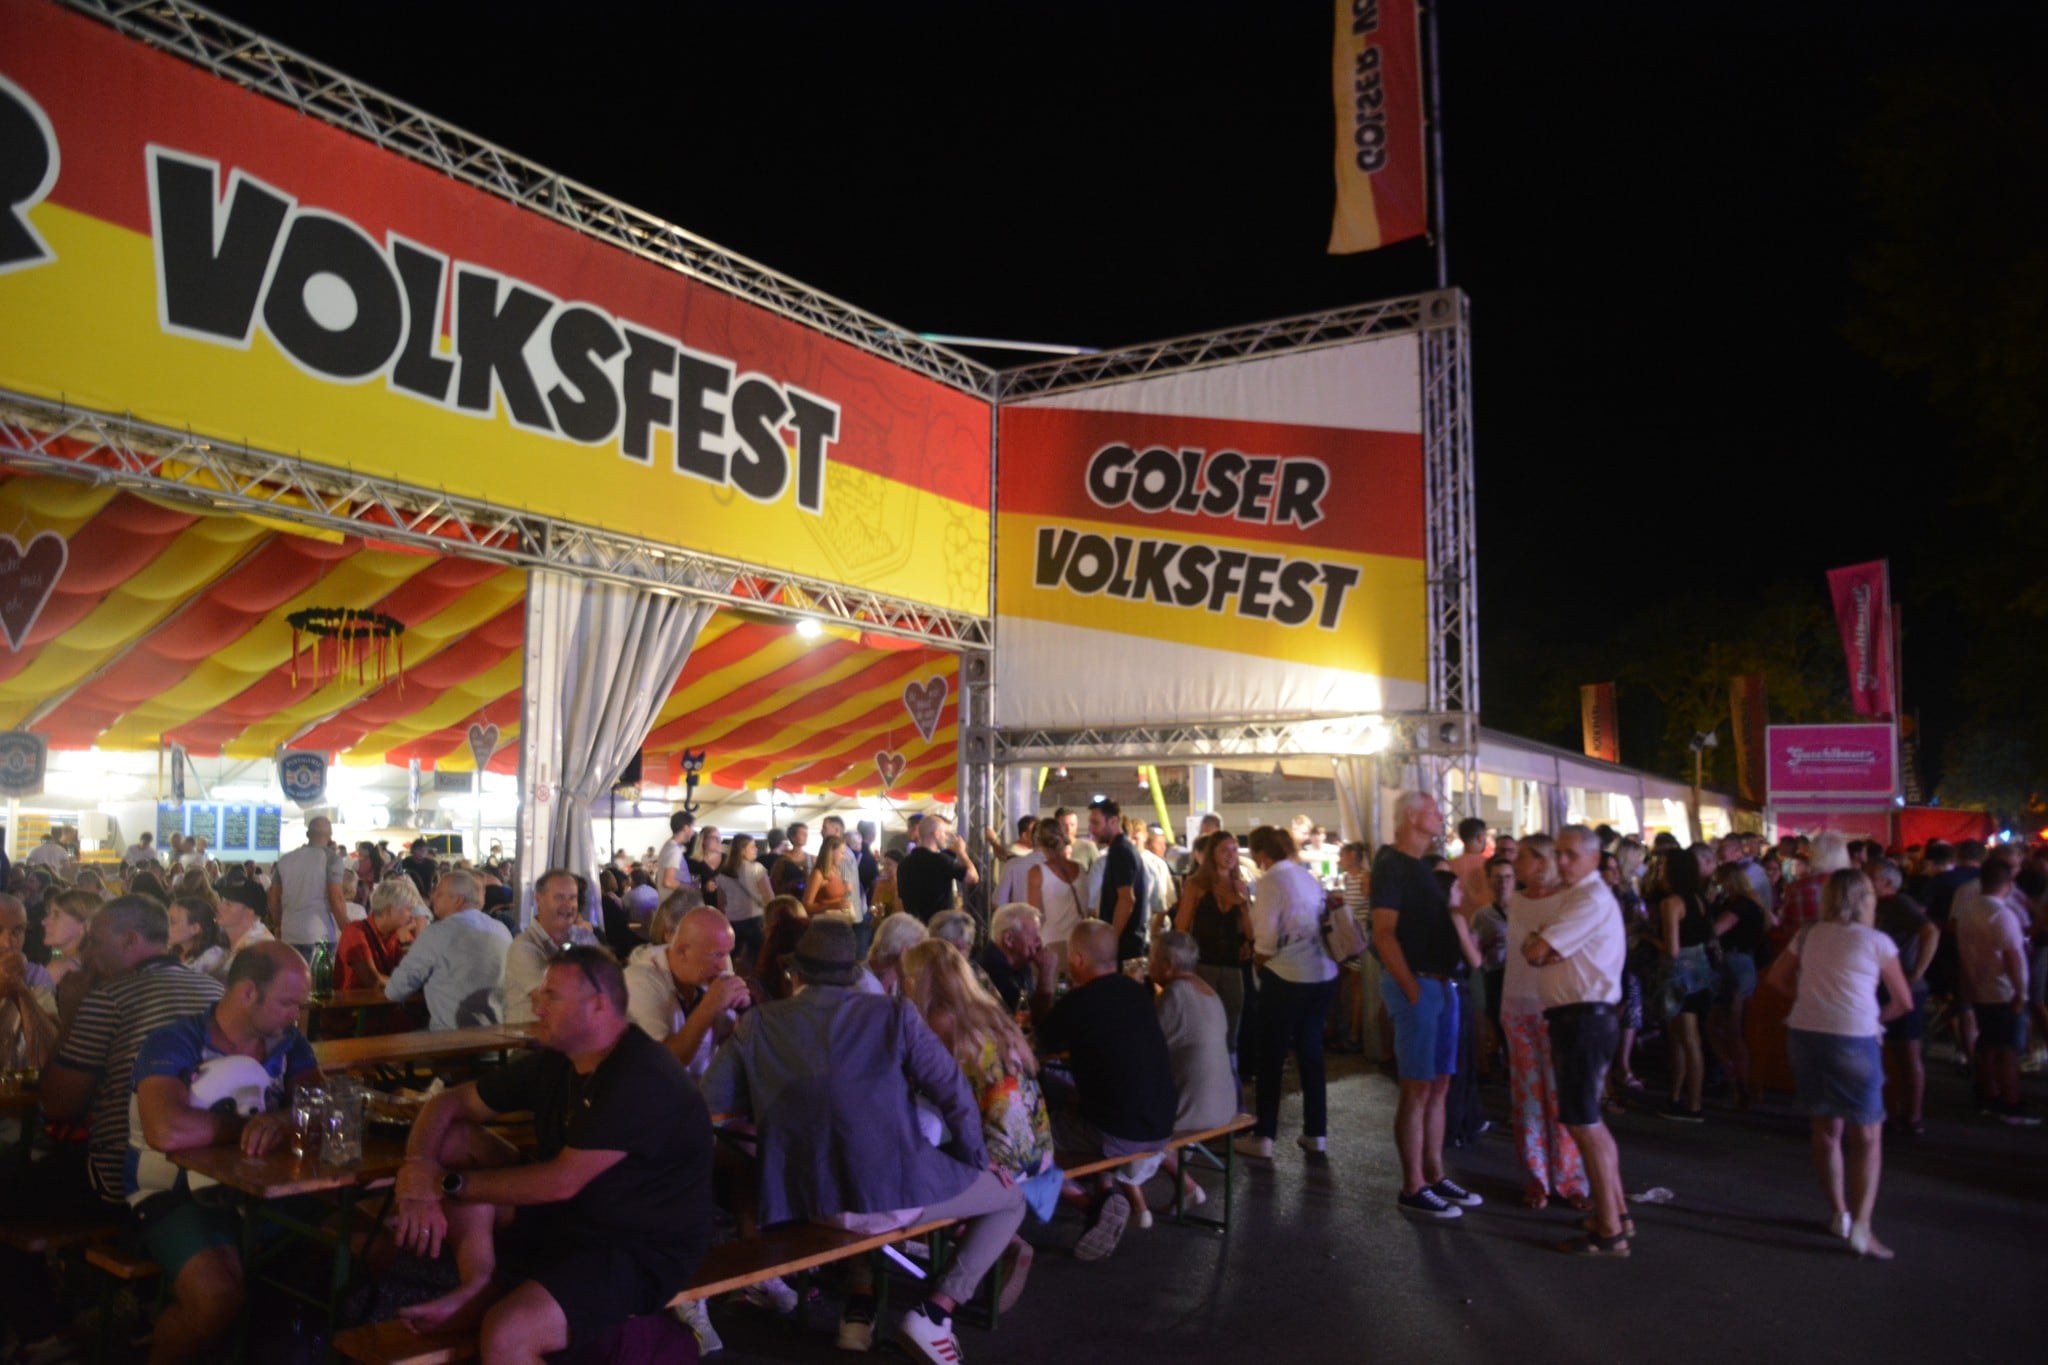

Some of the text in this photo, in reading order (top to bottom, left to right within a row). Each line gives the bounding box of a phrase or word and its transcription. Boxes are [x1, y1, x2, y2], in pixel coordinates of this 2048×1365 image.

[146, 142, 842, 517] VOLKSFEST
[1085, 442, 1329, 530] GOLSER
[1033, 526, 1363, 631] VOLKSFEST
